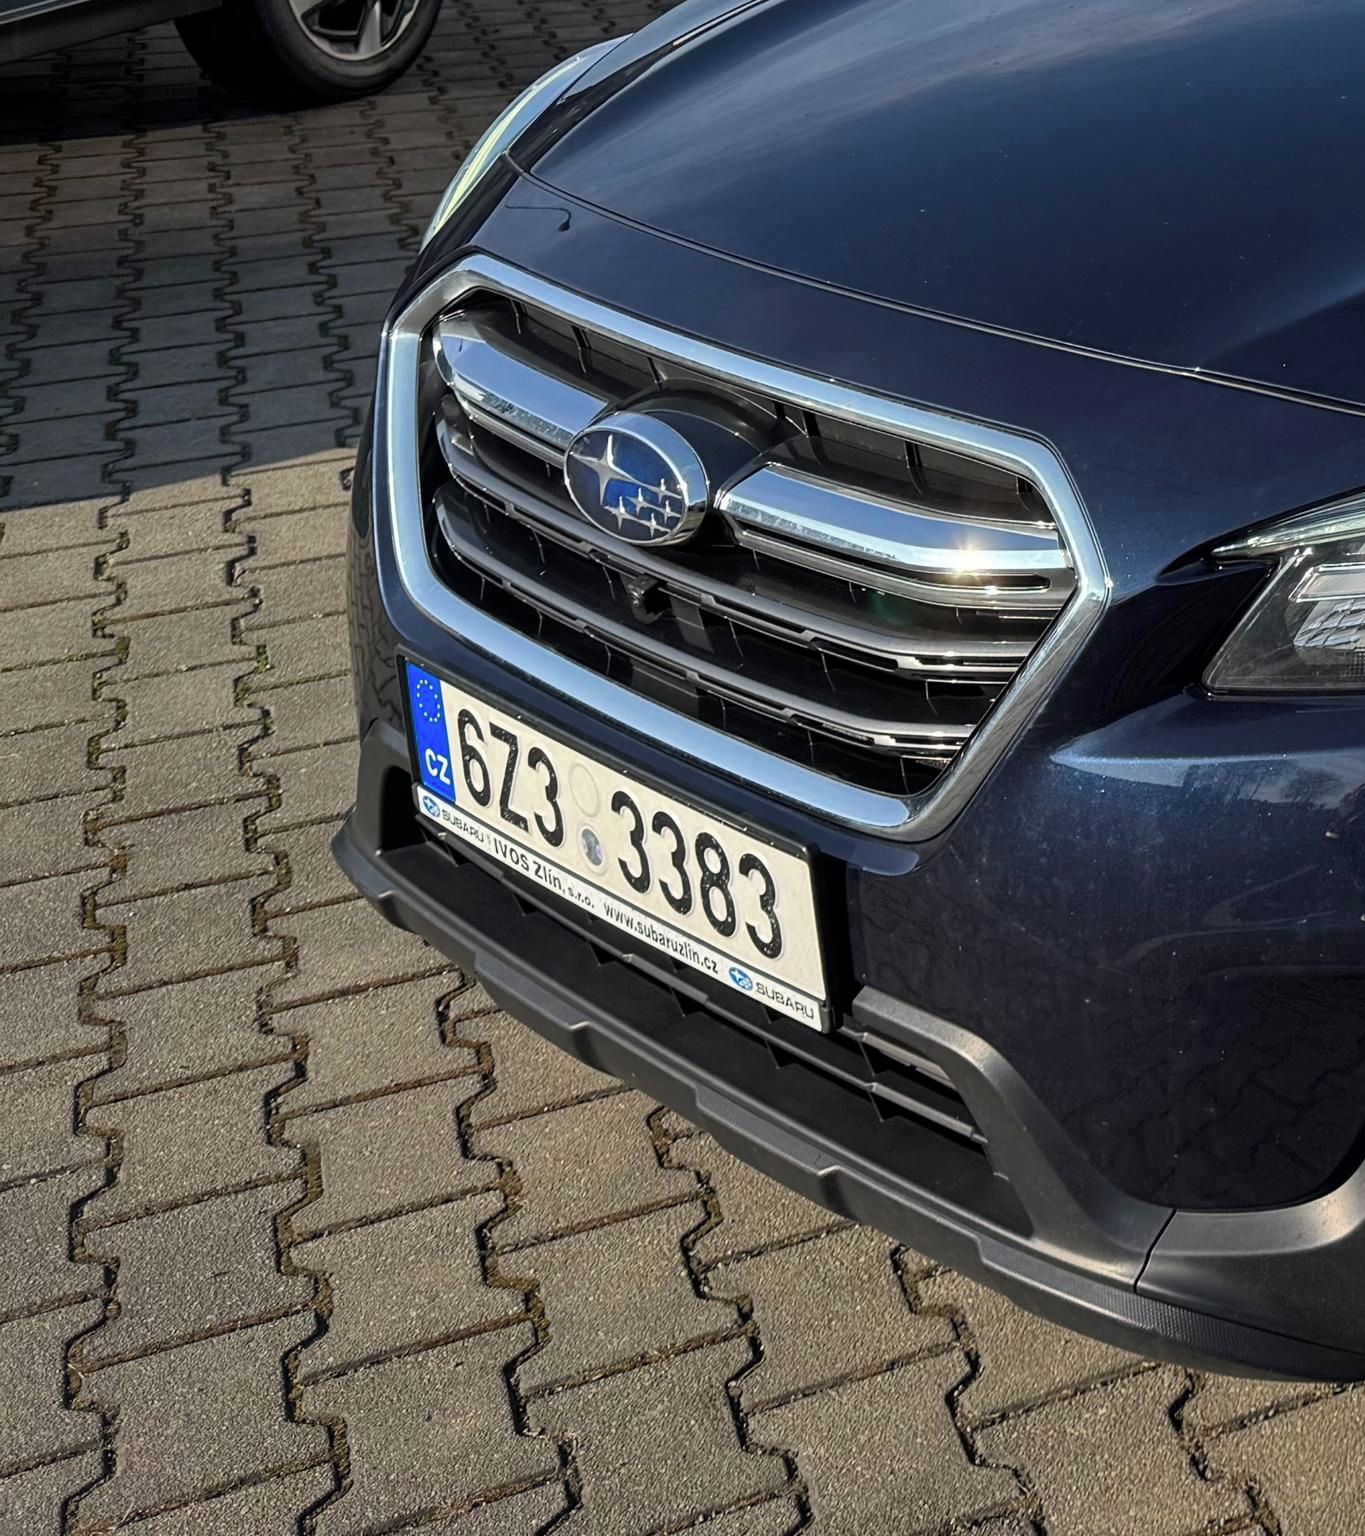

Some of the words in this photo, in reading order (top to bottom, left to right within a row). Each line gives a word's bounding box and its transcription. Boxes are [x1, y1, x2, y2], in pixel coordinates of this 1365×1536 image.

[425, 748, 451, 785] CZ
[457, 708, 564, 848] 6Z3
[611, 790, 783, 960] 3383
[441, 809, 484, 842] SUBARU
[493, 837, 530, 872] IVOS
[567, 886, 595, 909] s.r.o.
[603, 901, 719, 975] www.subaruzlin.cz
[755, 981, 815, 1020] SUBARU
